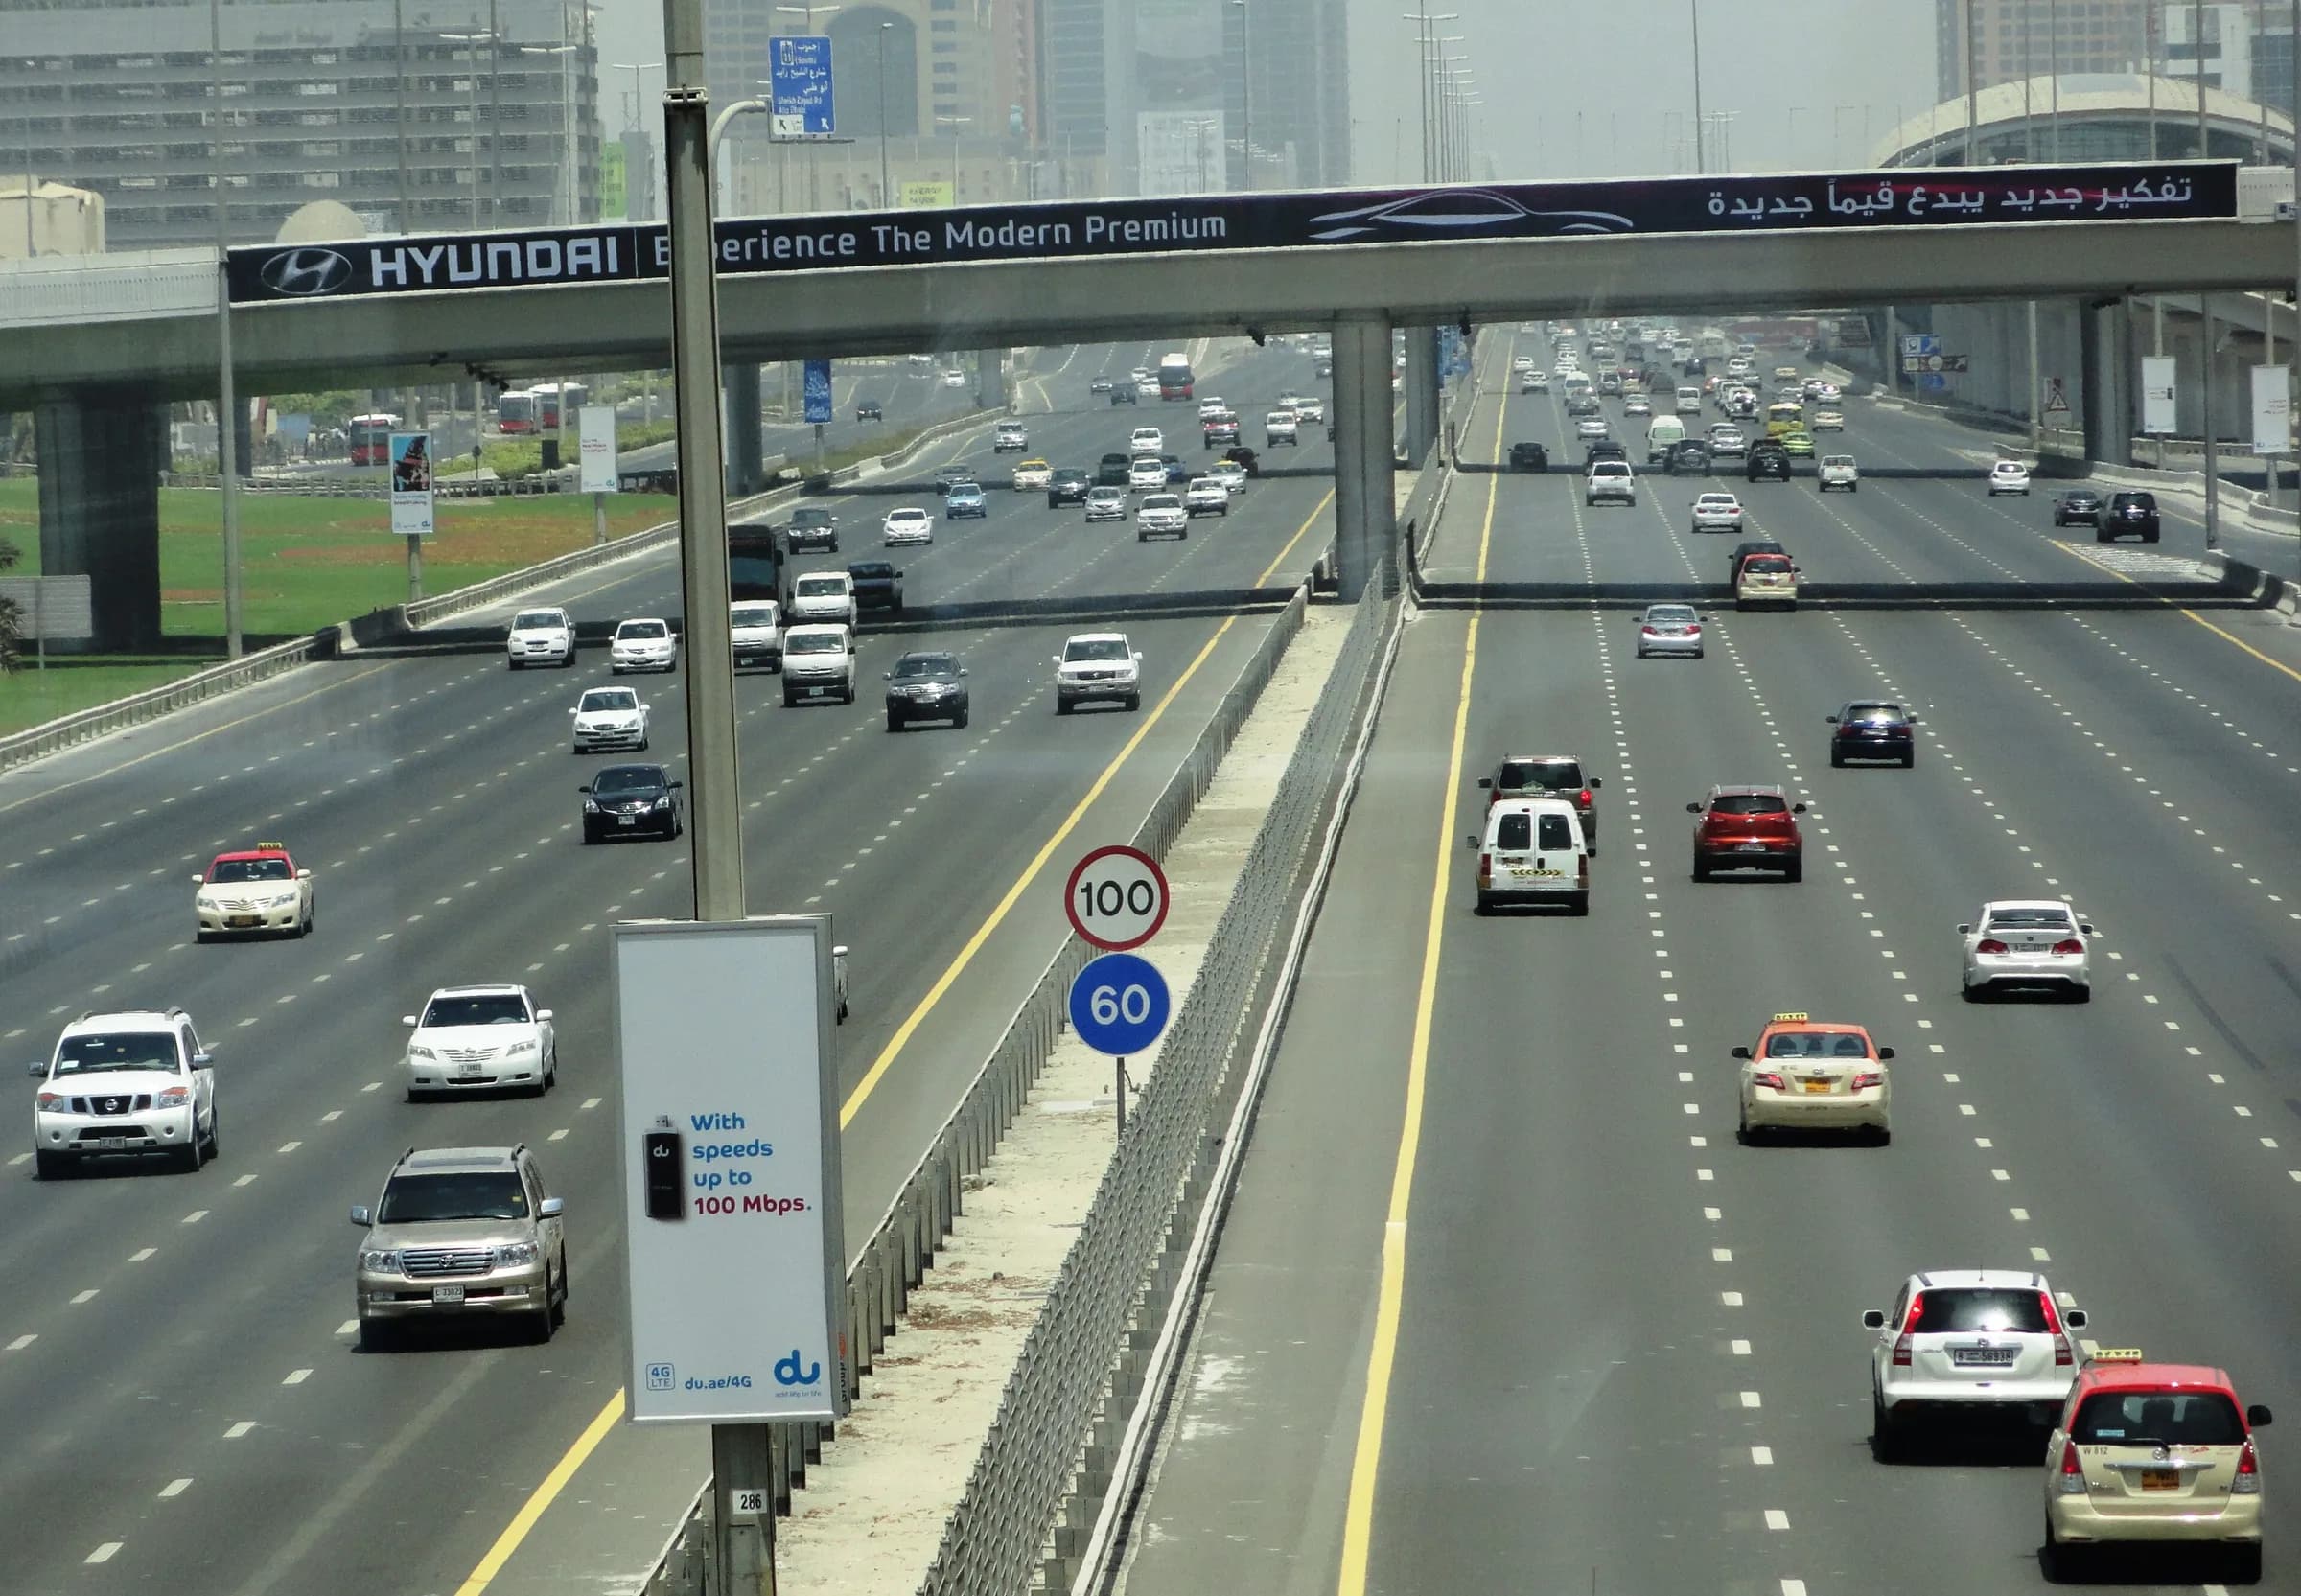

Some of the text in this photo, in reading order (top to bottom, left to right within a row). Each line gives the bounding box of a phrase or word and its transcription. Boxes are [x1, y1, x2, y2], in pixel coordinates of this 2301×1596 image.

[1708, 176, 2193, 220] تفكير جديد يبدع قيماً جديدة
[655, 211, 1226, 266] Eerience The Modern Premium
[370, 236, 620, 287] HYUNDAI
[1081, 880, 1154, 917] 100
[1090, 984, 1150, 1025] 60
[690, 1112, 745, 1131] With
[653, 1144, 670, 1158] du
[692, 1139, 773, 1163] speeds
[693, 1169, 752, 1190] up to
[694, 1194, 812, 1216] 100 Mbps.
[651, 1366, 670, 1377] 4G
[774, 1350, 820, 1386] du
[651, 1378, 670, 1389] LTE
[685, 1375, 752, 1390] du.ae/4G
[741, 1494, 761, 1510] 286
